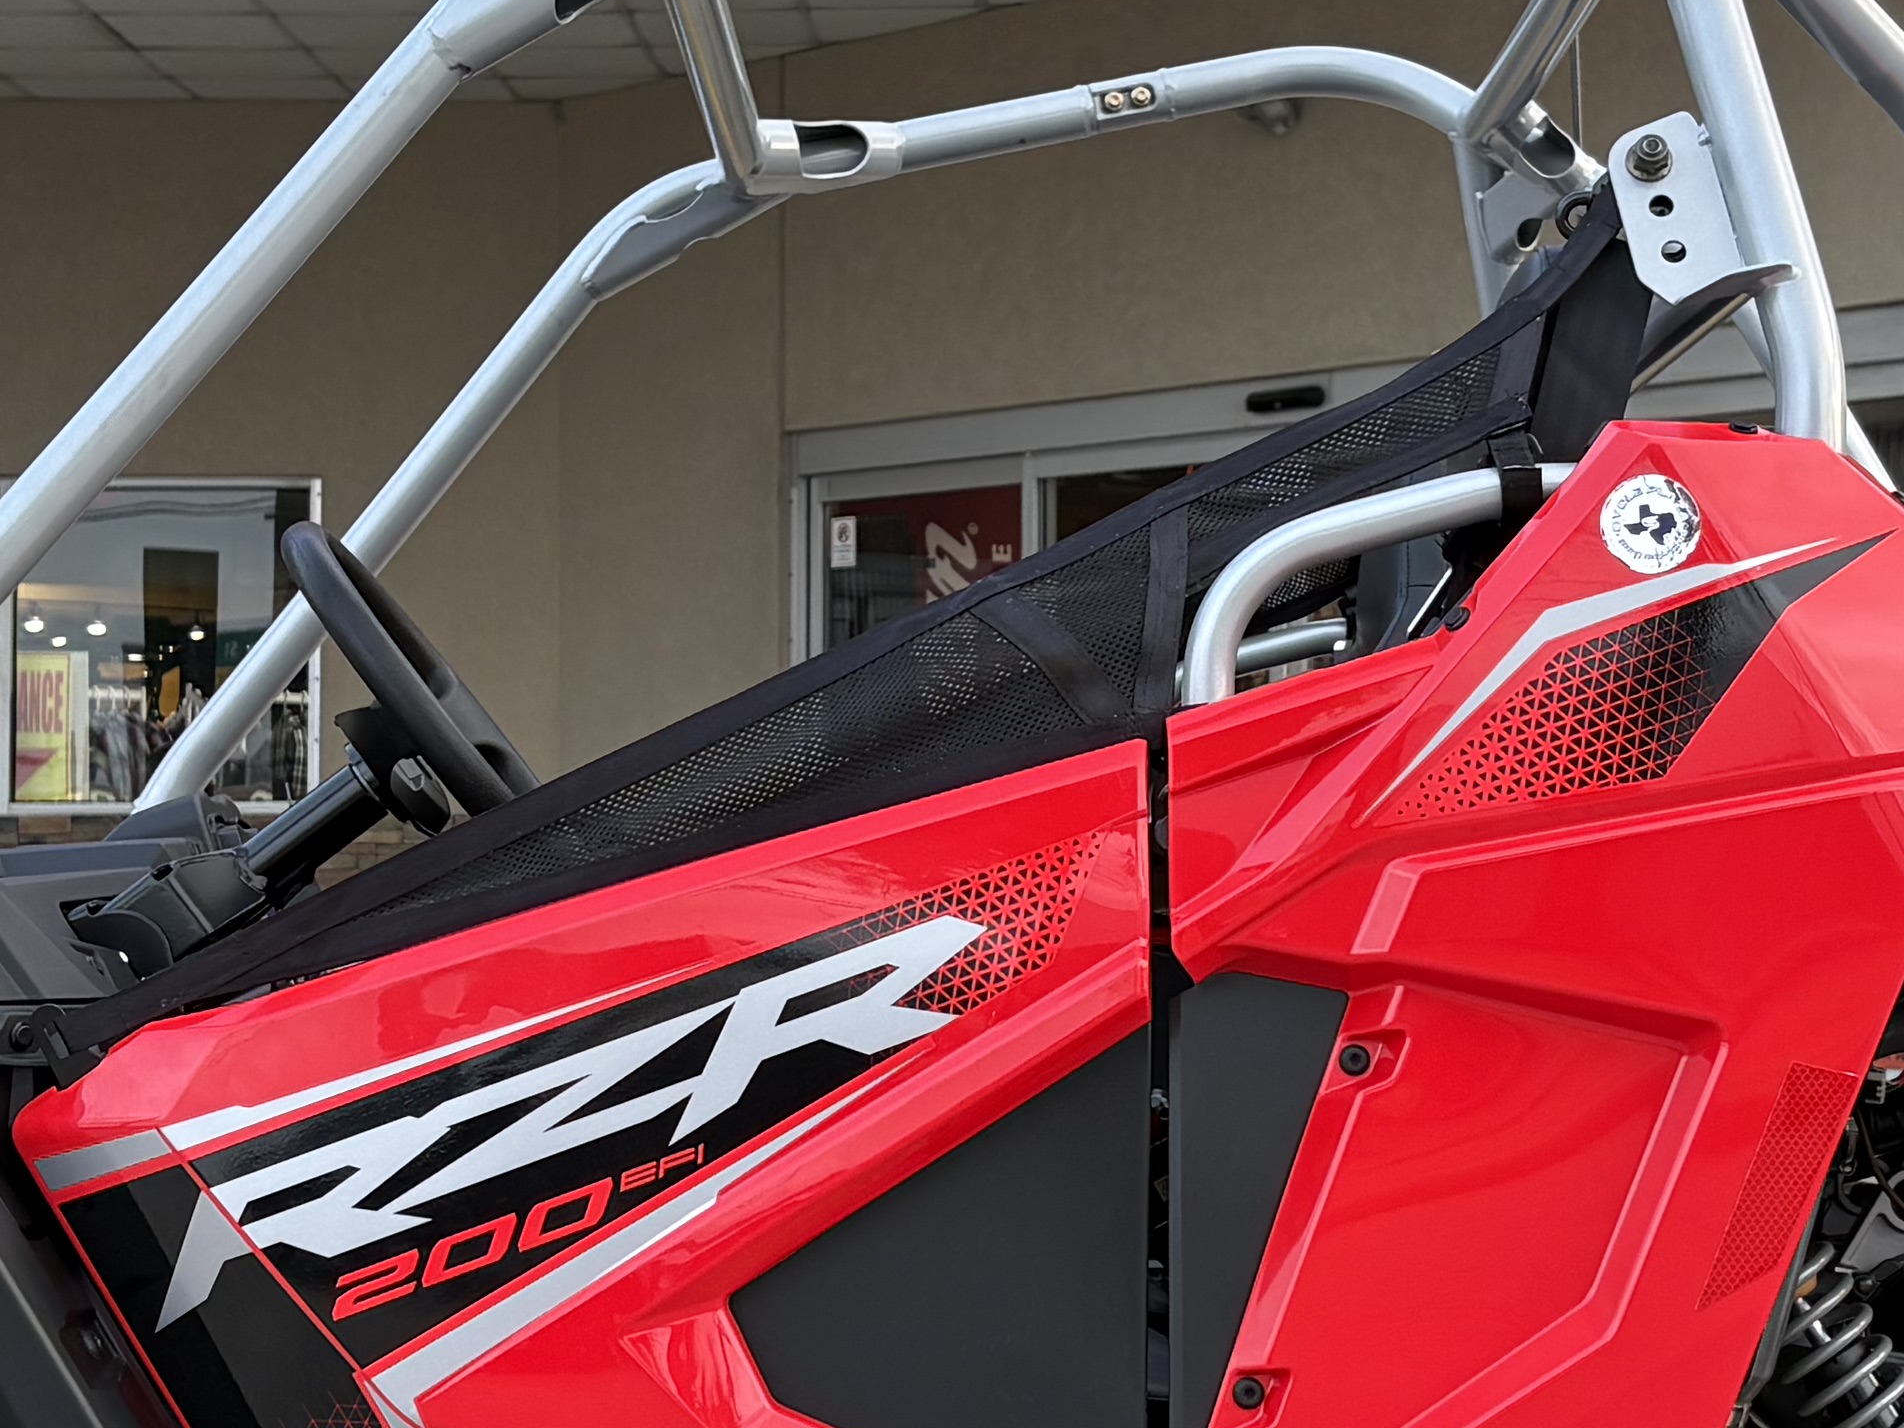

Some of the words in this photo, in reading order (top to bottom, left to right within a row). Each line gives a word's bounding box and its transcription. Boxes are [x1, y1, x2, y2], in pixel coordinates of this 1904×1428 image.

[154, 914, 987, 1333] RZR
[331, 1178, 615, 1321] 200
[618, 1142, 706, 1194] EFI
